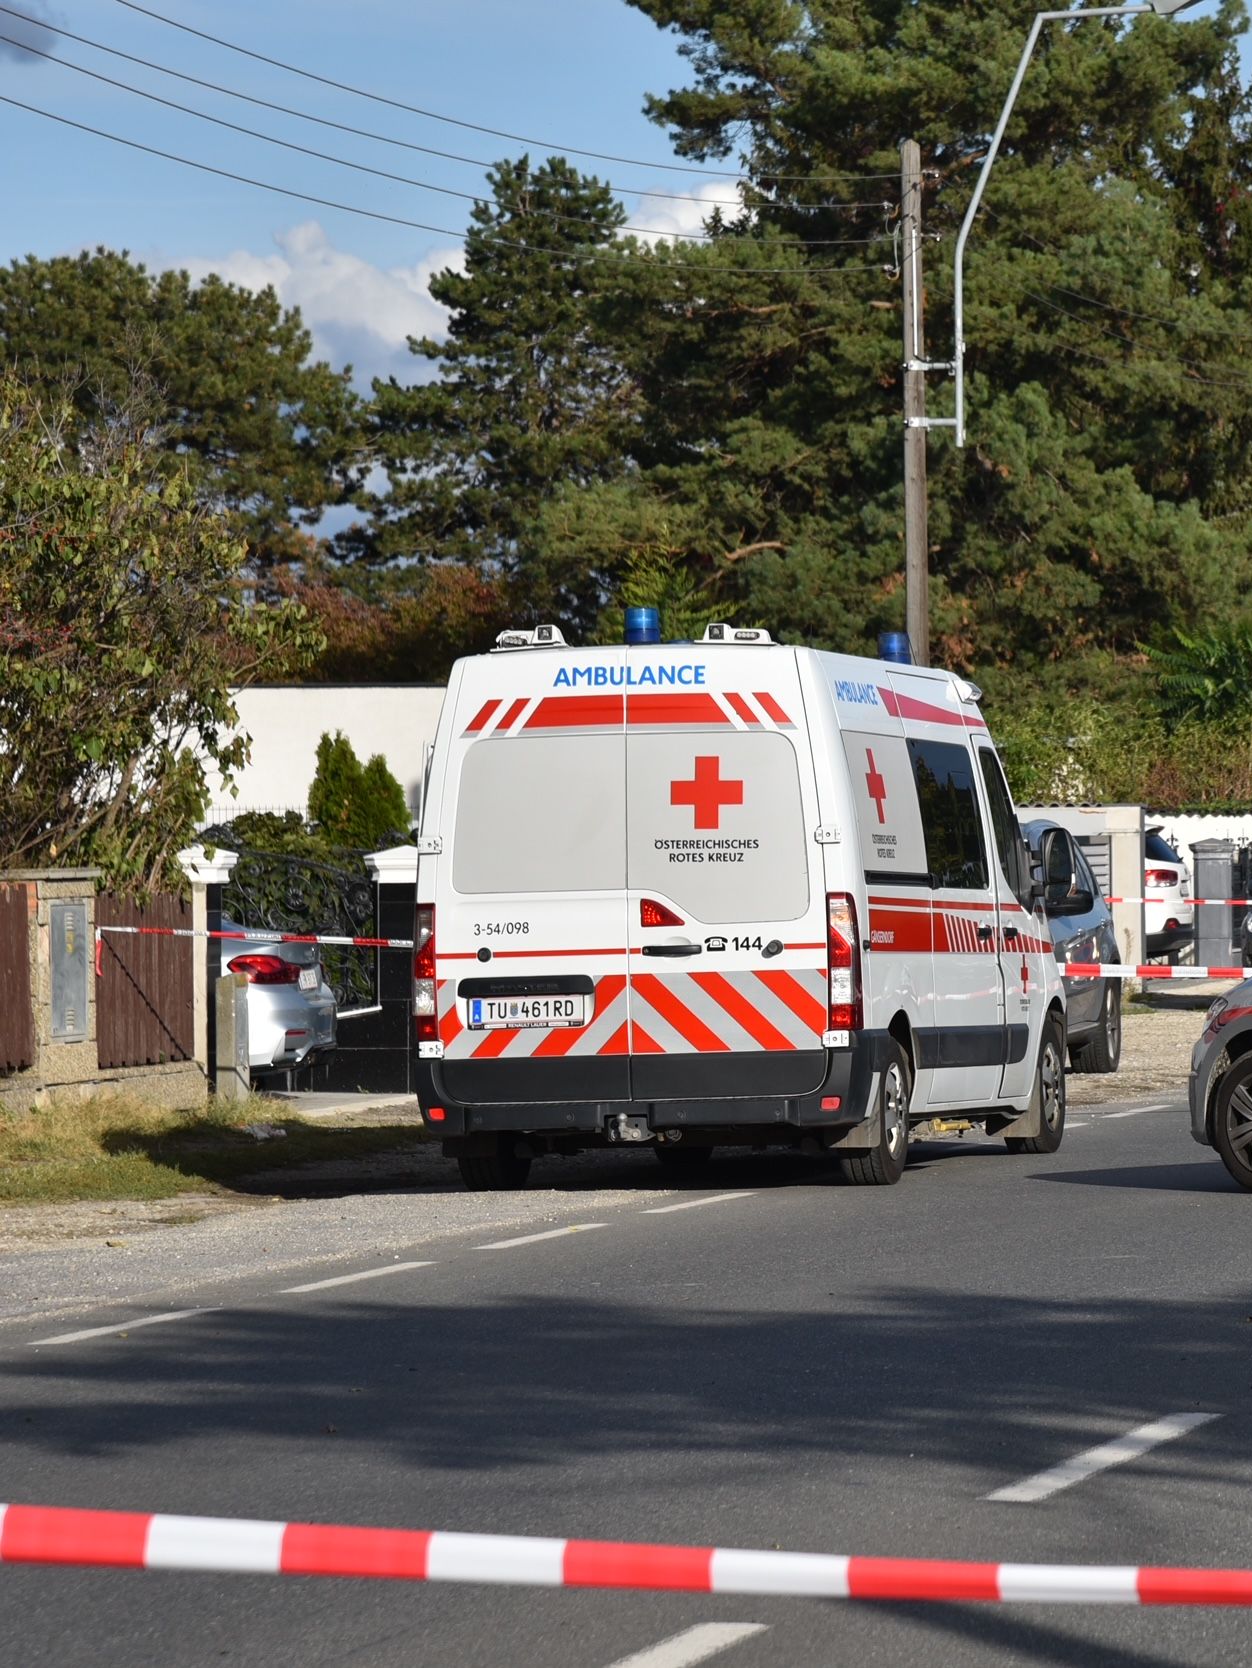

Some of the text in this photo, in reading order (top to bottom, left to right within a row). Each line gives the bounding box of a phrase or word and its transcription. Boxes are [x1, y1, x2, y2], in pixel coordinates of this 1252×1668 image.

[553, 665, 705, 687] AMBULANCE
[654, 838, 759, 850] ÖSTERREICHISCHES
[669, 852, 744, 863] ROTES KREUZ
[474, 921, 530, 936] 3-54/098
[732, 936, 763, 951] 144
[488, 1002, 507, 1019] TU
[521, 1000, 574, 1018] 461RD
